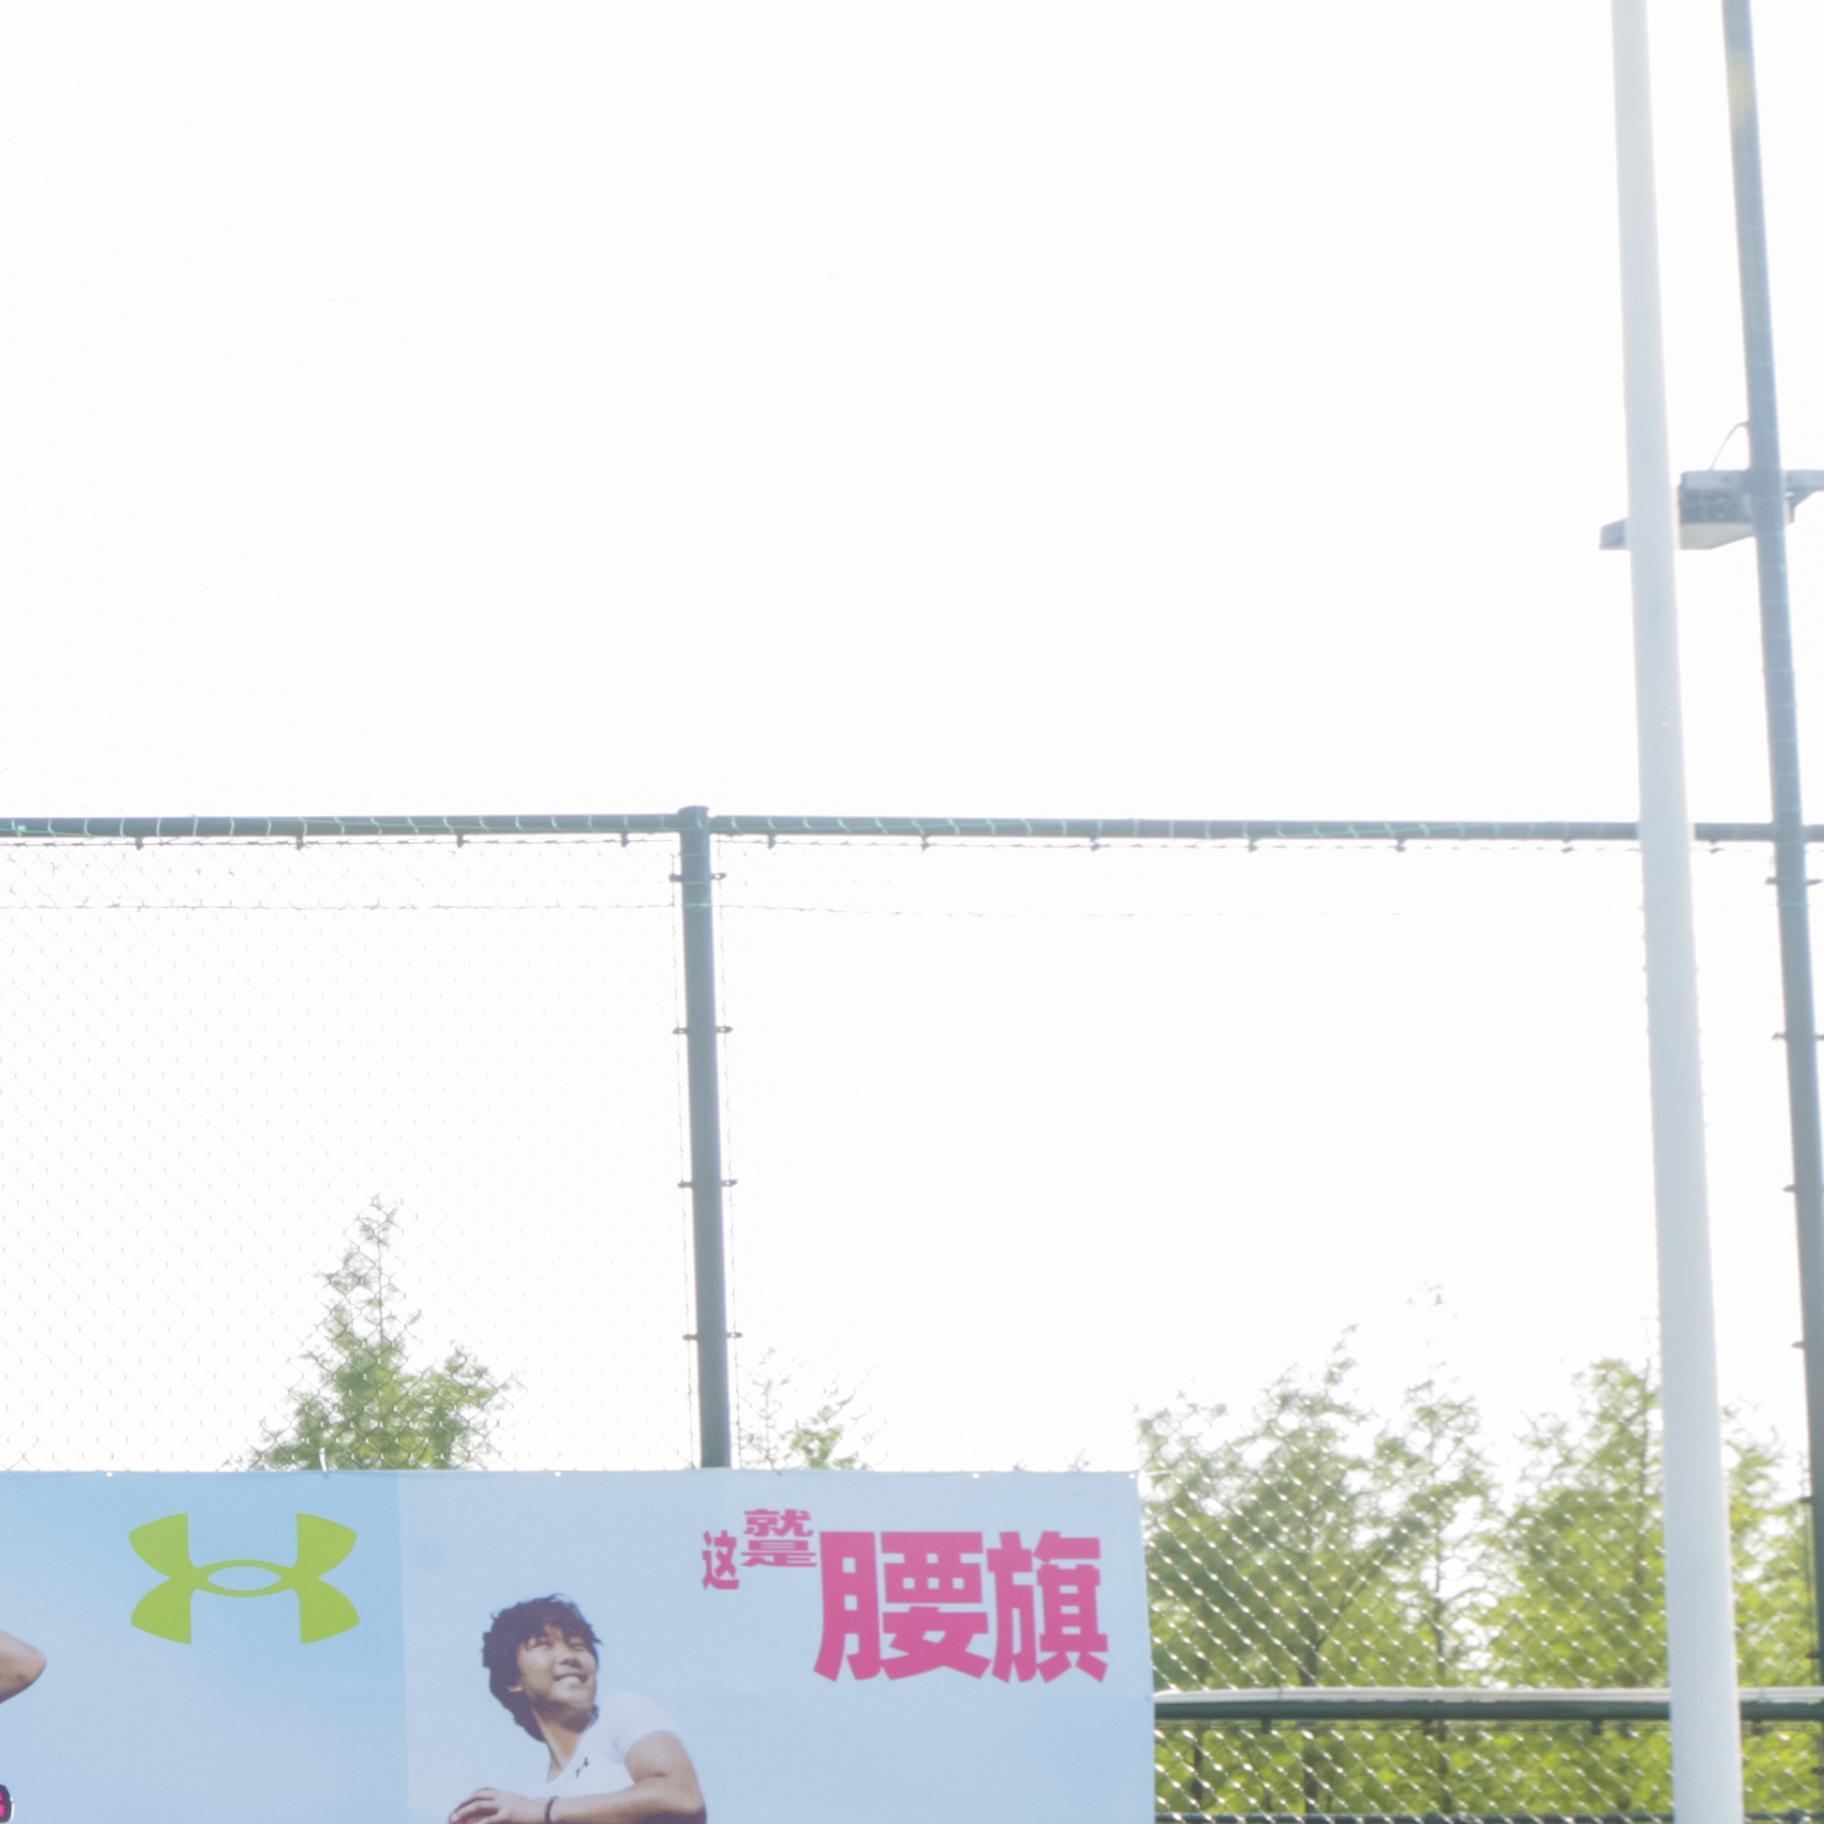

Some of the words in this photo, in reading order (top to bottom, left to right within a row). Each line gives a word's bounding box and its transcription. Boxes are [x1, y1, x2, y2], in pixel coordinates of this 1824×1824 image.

[703, 1508, 1109, 1683] 这就是腰旗
